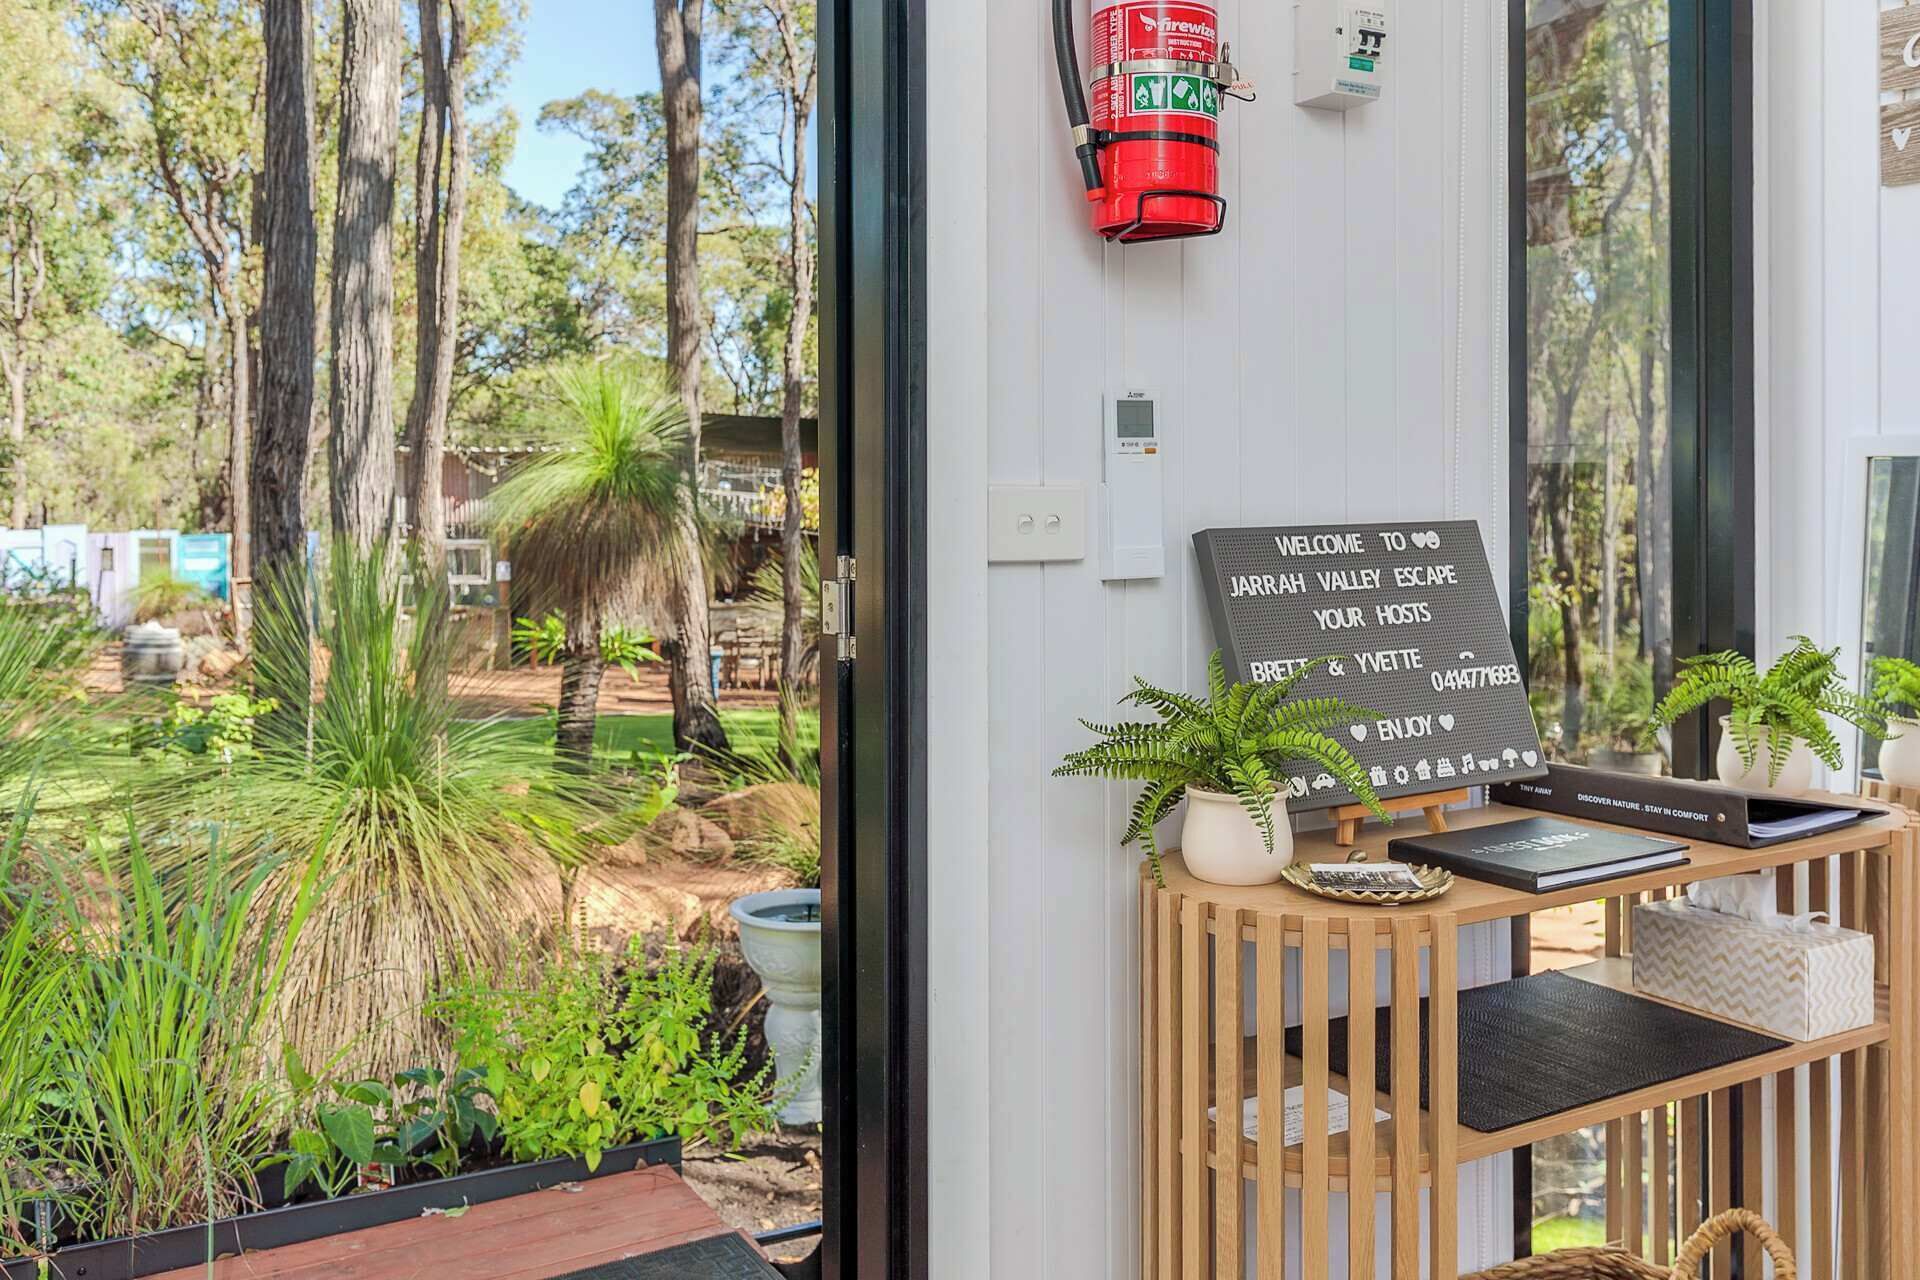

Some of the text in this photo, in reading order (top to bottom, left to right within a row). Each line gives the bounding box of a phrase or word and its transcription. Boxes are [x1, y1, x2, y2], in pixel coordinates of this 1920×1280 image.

[1158, 17, 1215, 38] firewize
[1275, 531, 1406, 556] WELCOME TO
[1230, 565, 1457, 597] JARRAH VALLEY ESCAPE
[1313, 603, 1432, 630] YOUR HOSTS
[1250, 648, 1423, 683] BRETT & YVETTE
[1430, 664, 1521, 692] 0414771693
[1376, 715, 1433, 741] ENJOY
[1519, 784, 1553, 796] TINY AWAY
[1577, 793, 1612, 806] DISCOVER
[1612, 799, 1640, 811] NATURE
[1644, 805, 1663, 815] STAY
[1664, 807, 1671, 816] IN
[1672, 809, 1709, 822] COMFORT
